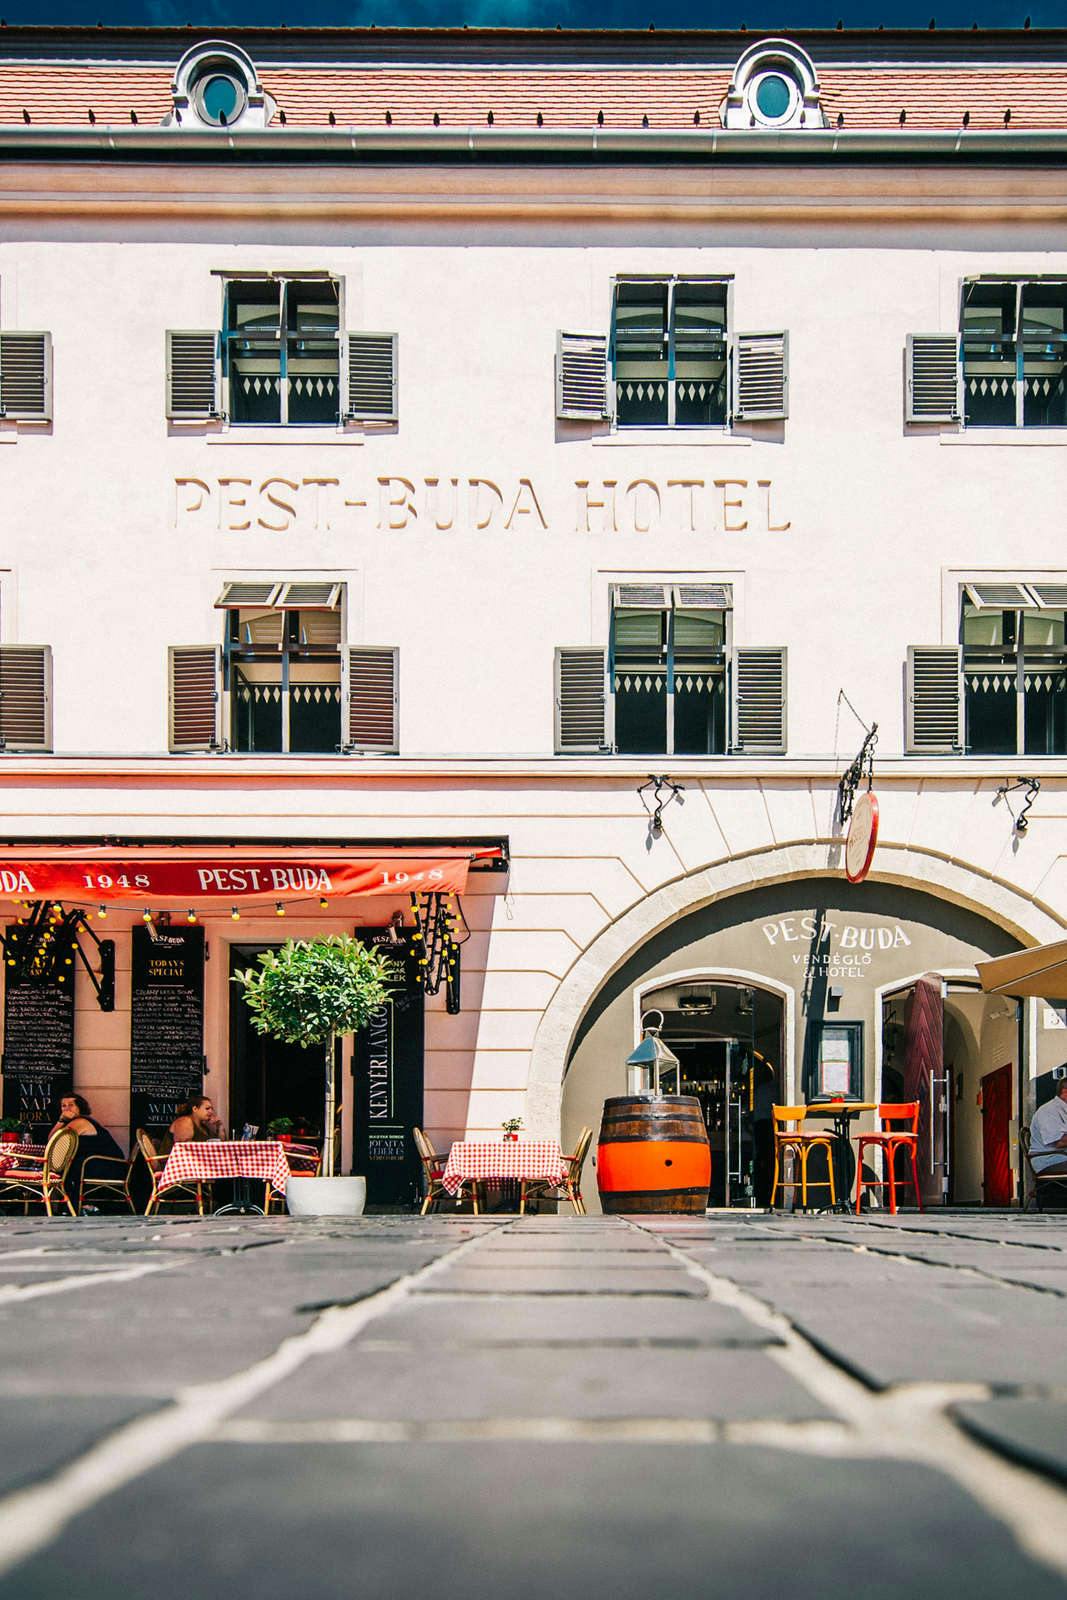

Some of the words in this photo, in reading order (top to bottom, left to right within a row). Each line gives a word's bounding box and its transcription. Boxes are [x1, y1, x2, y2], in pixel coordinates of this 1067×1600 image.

[174, 476, 549, 531] PEST-BUDA
[574, 479, 792, 532] HOTEL
[83, 874, 151, 889] 1948
[147, 968, 185, 977] SPECIAL
[819, 967, 865, 978] HOTEL
[20, 1083, 52, 1096] MAI
[20, 1097, 52, 1110] NAP
